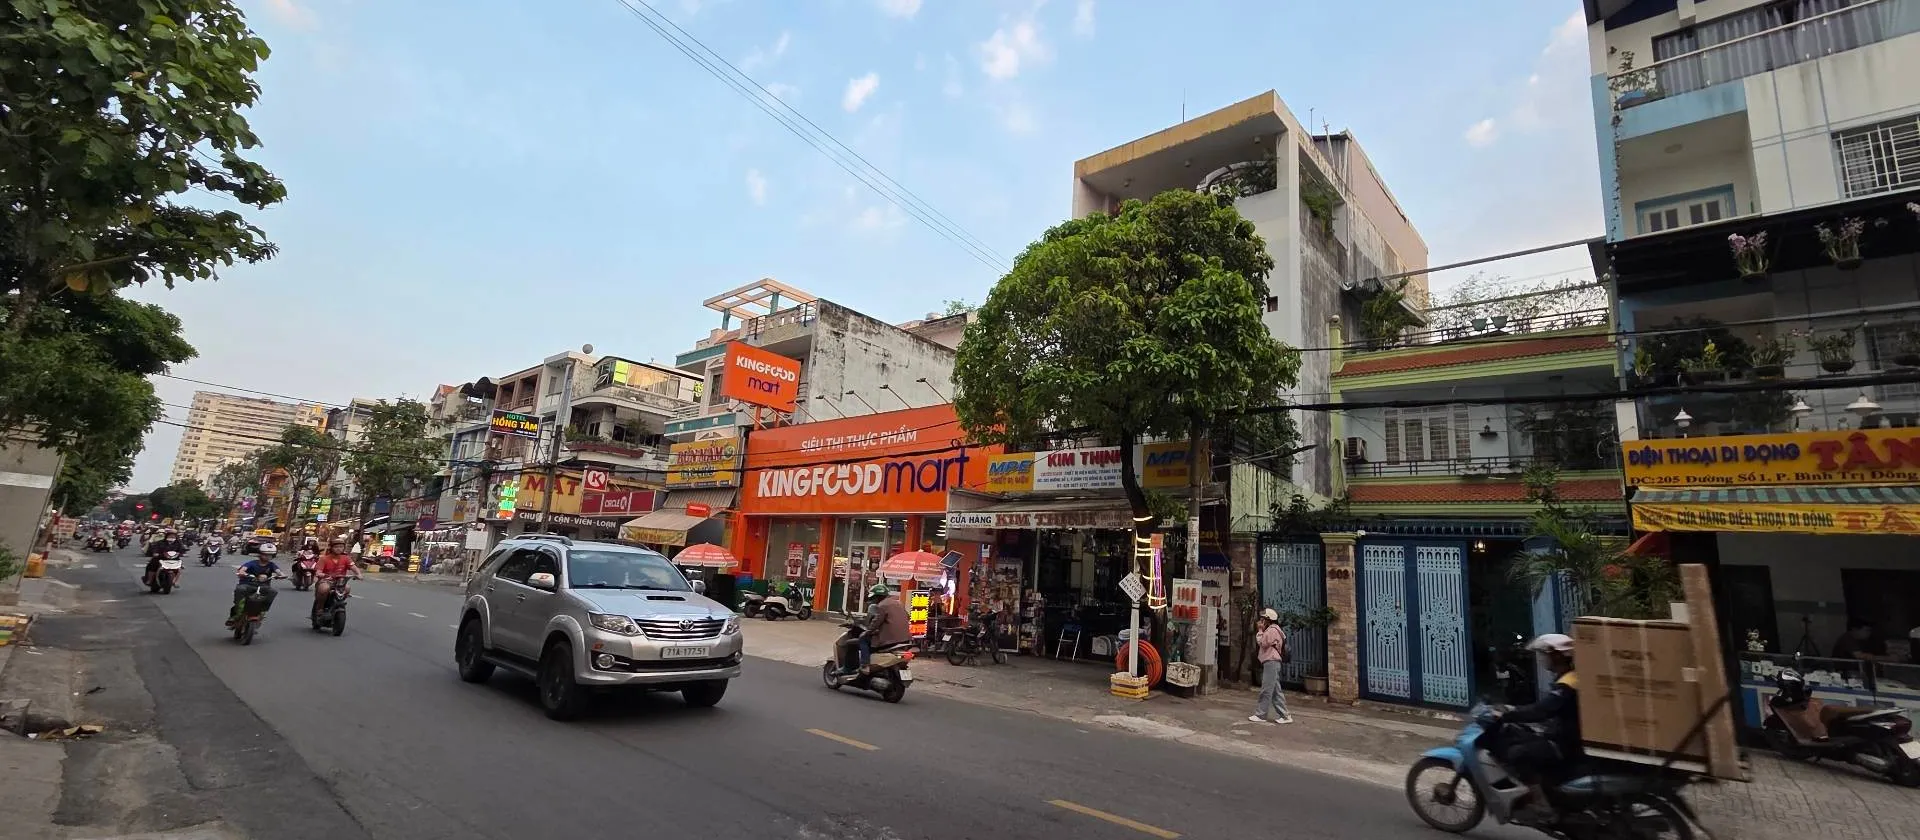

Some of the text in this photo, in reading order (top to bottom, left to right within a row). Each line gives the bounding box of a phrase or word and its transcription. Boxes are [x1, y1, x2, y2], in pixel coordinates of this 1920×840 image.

[736, 355, 796, 381] KINGFOOD
[748, 376, 780, 395] mart
[506, 413, 527, 421] HOTEL
[800, 425, 918, 452] SIÊU THỊ THỰC PHẨM
[1047, 453, 1075, 467] KIM
[1667, 446, 1717, 467] THOẠI
[1721, 446, 1739, 463] DI
[757, 447, 970, 498] KINGFOOD mart
[989, 460, 1032, 473] MPE
[950, 511, 967, 524] CỬA
[969, 512, 992, 524] HÀNG
